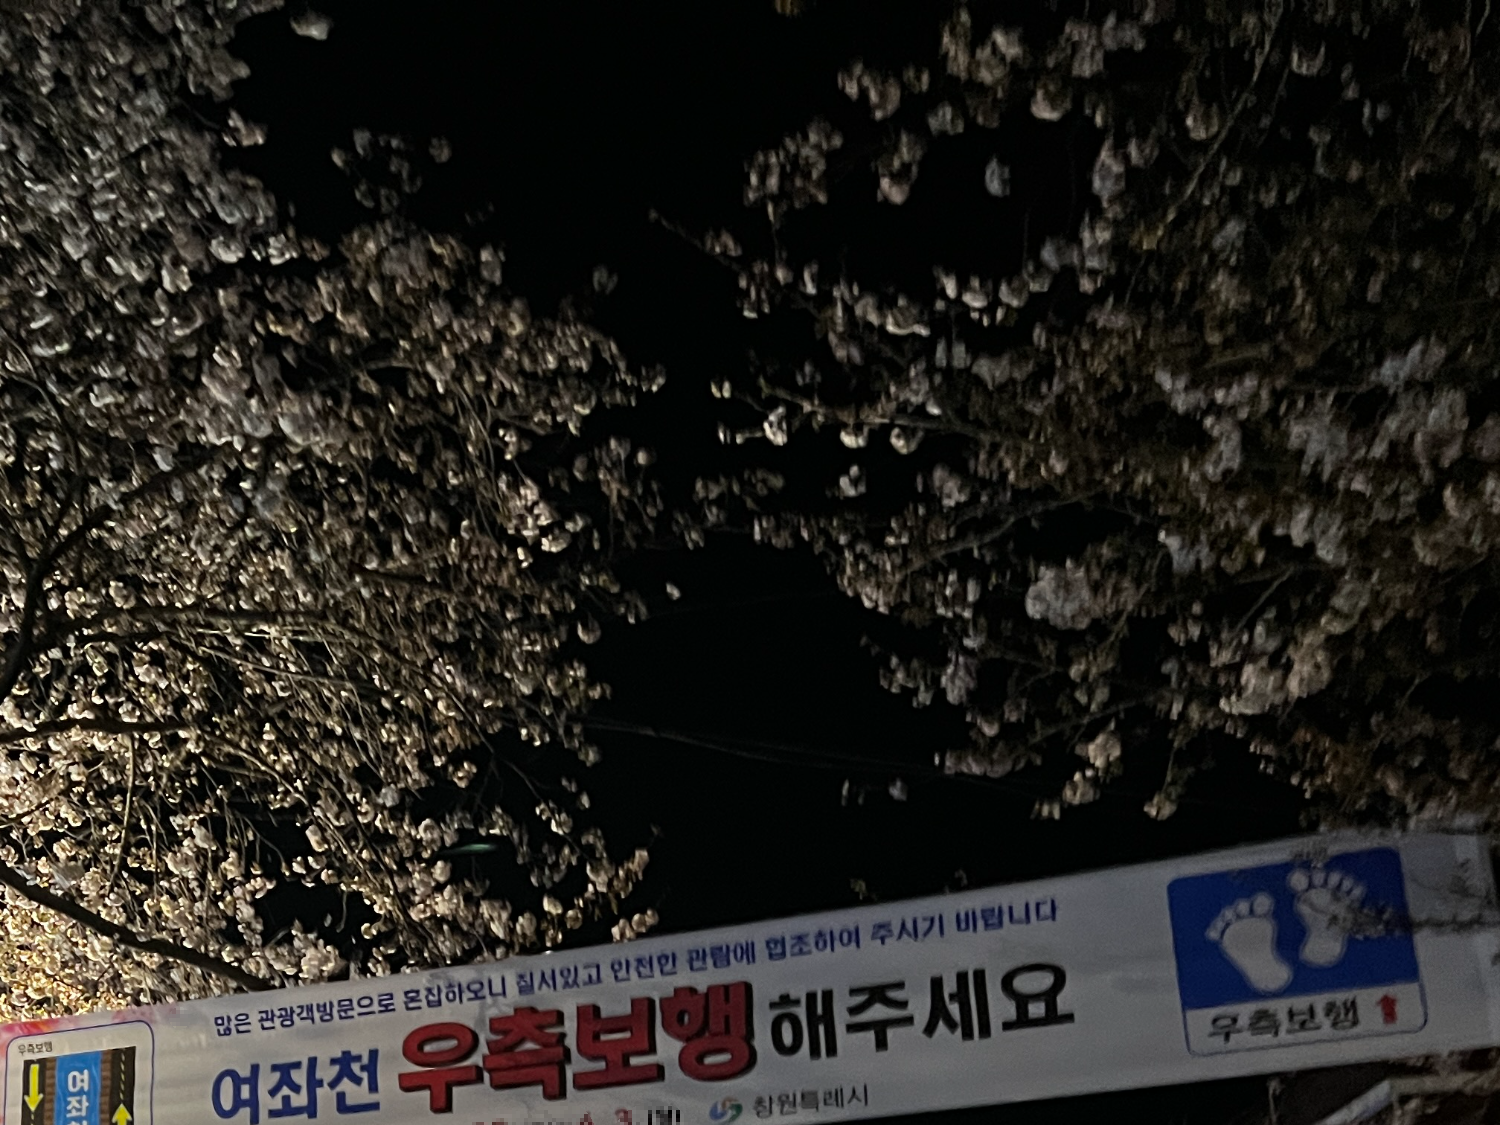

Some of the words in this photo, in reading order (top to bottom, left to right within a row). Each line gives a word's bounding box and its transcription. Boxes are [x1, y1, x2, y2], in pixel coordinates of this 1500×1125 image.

[214, 1013, 252, 1037] 많은
[258, 993, 396, 1031] 관광객방문으로
[403, 976, 507, 1011] 혼잡하오니
[516, 961, 602, 996] 질서있고
[611, 951, 678, 983] 안전한
[687, 940, 756, 973] 관람에
[765, 925, 861, 962] 협조하여
[871, 913, 945, 946] 주시기
[956, 898, 1060, 933] 바랍니다
[398, 980, 758, 1115] 우측보행
[769, 963, 1076, 1061] 해주세요
[1207, 996, 1361, 1044] 우측보행
[753, 1082, 869, 1119] 창원특례시
